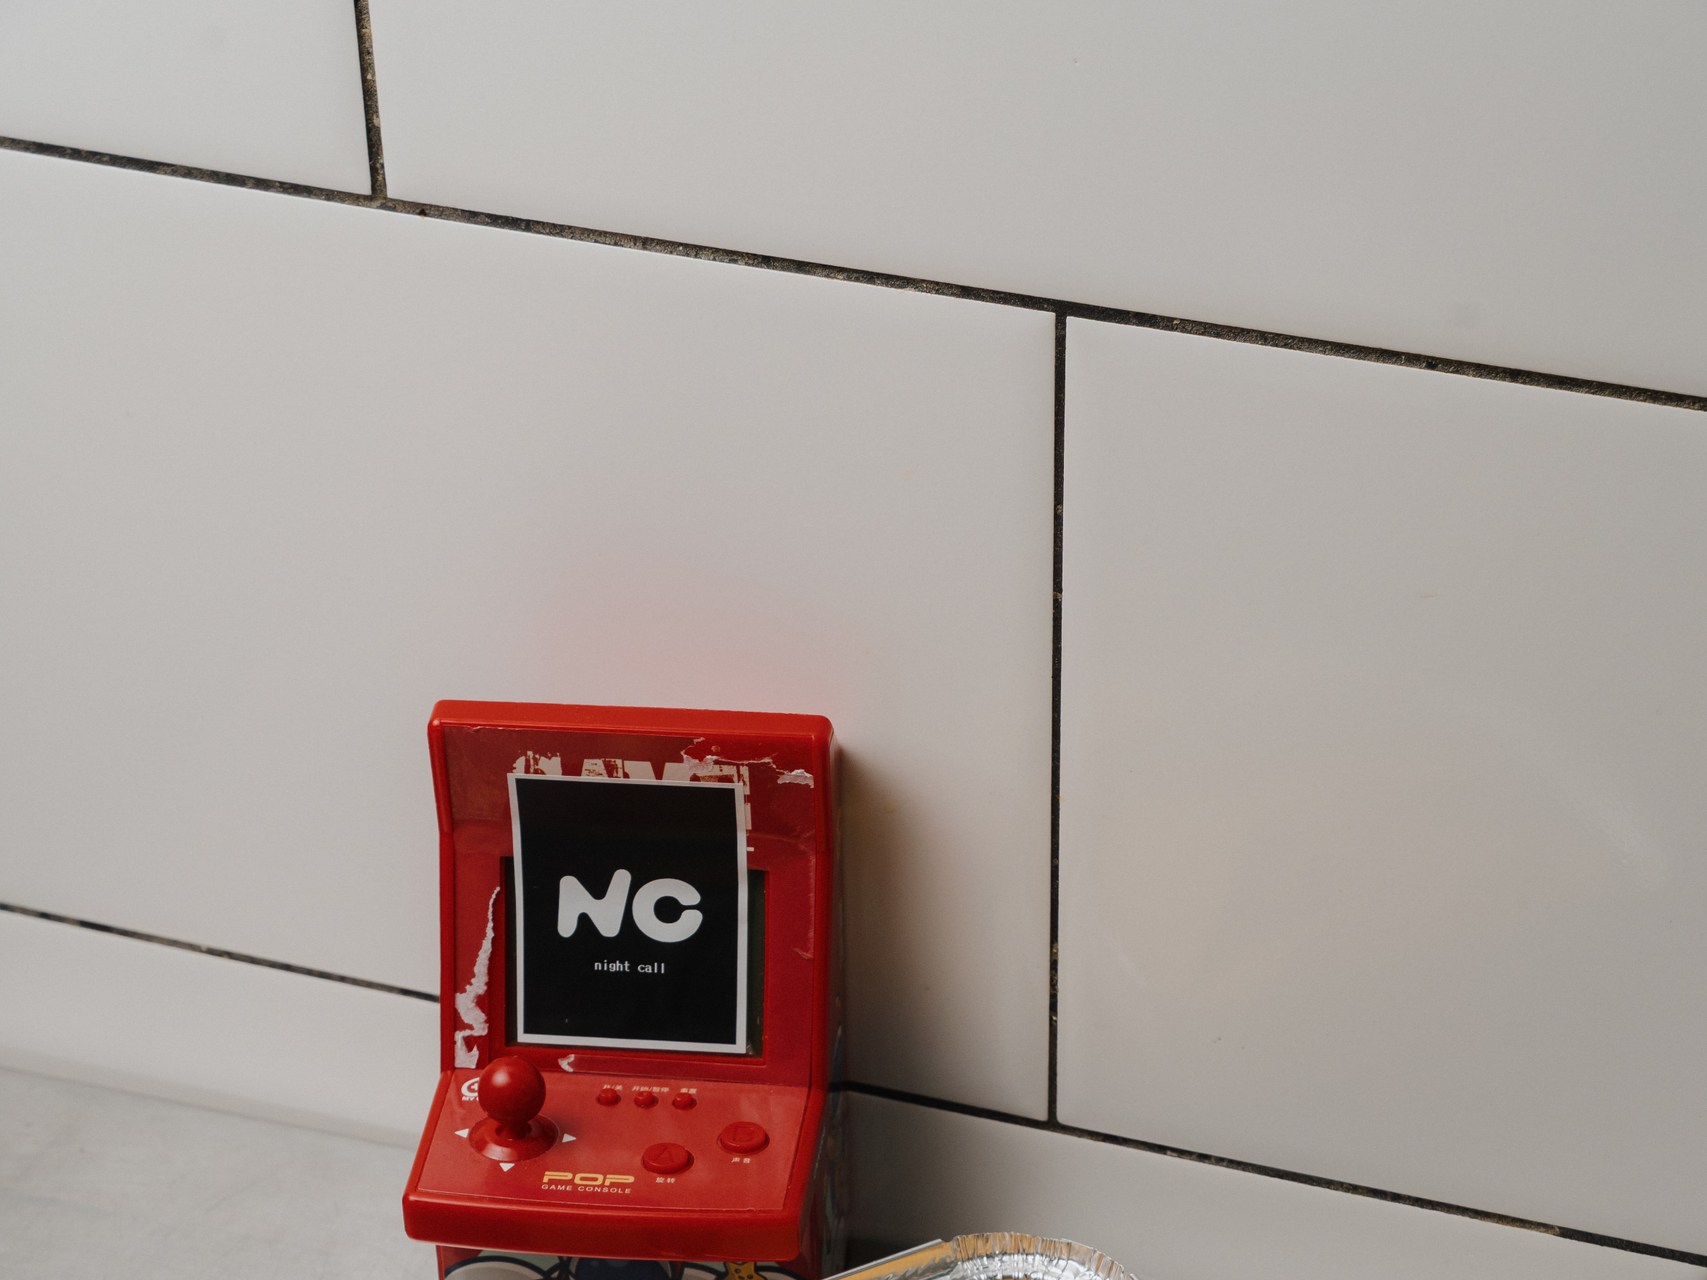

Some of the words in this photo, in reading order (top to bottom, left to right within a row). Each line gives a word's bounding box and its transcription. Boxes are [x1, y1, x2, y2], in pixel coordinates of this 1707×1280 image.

[557, 868, 704, 943] NC
[594, 960, 631, 972] night
[637, 962, 665, 974] call
[542, 1171, 635, 1186] POP
[541, 1183, 573, 1191] GAME
[577, 1185, 632, 1194] CONSOLE
